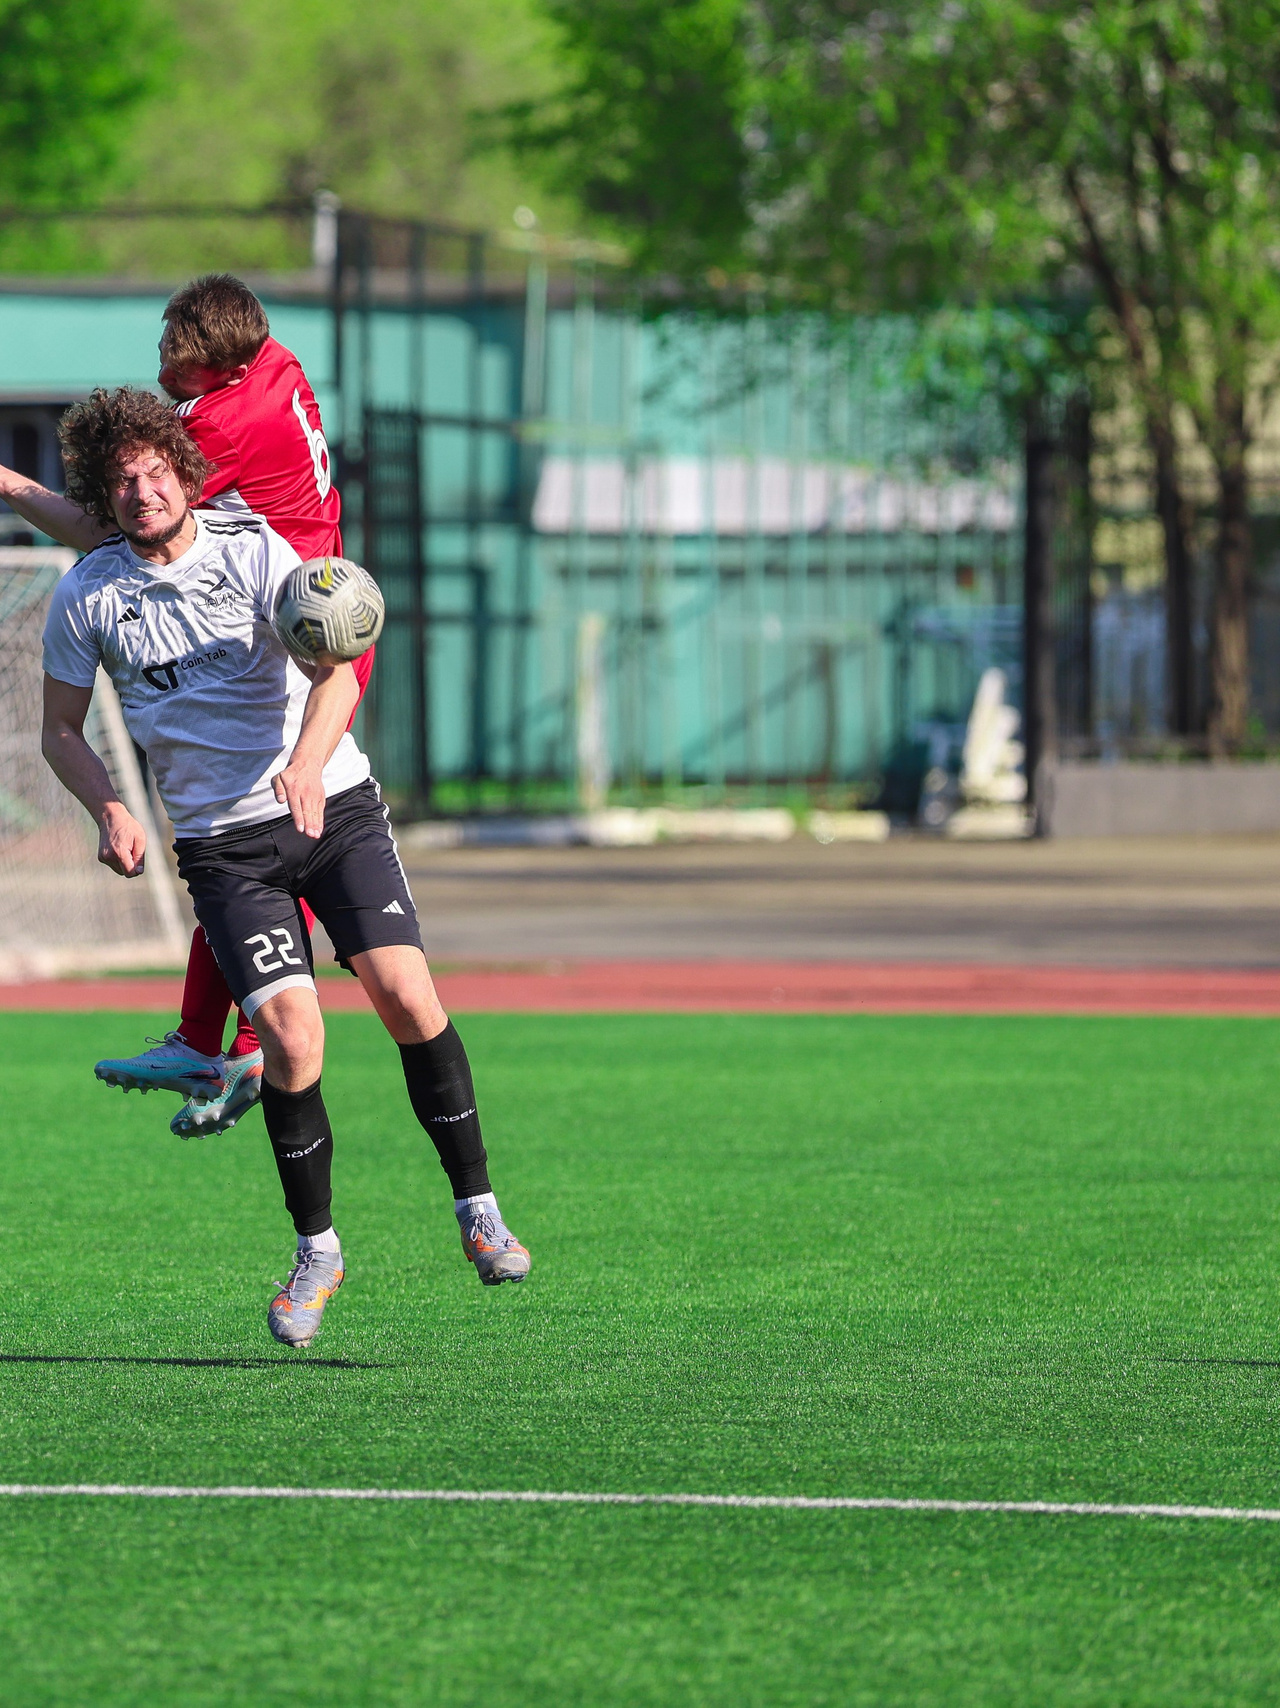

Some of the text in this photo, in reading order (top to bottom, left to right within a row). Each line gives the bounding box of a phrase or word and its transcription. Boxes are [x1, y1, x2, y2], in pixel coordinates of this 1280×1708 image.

[292, 387, 331, 505] 6
[141, 648, 227, 691] CT Coin Tab
[244, 928, 303, 974] 22
